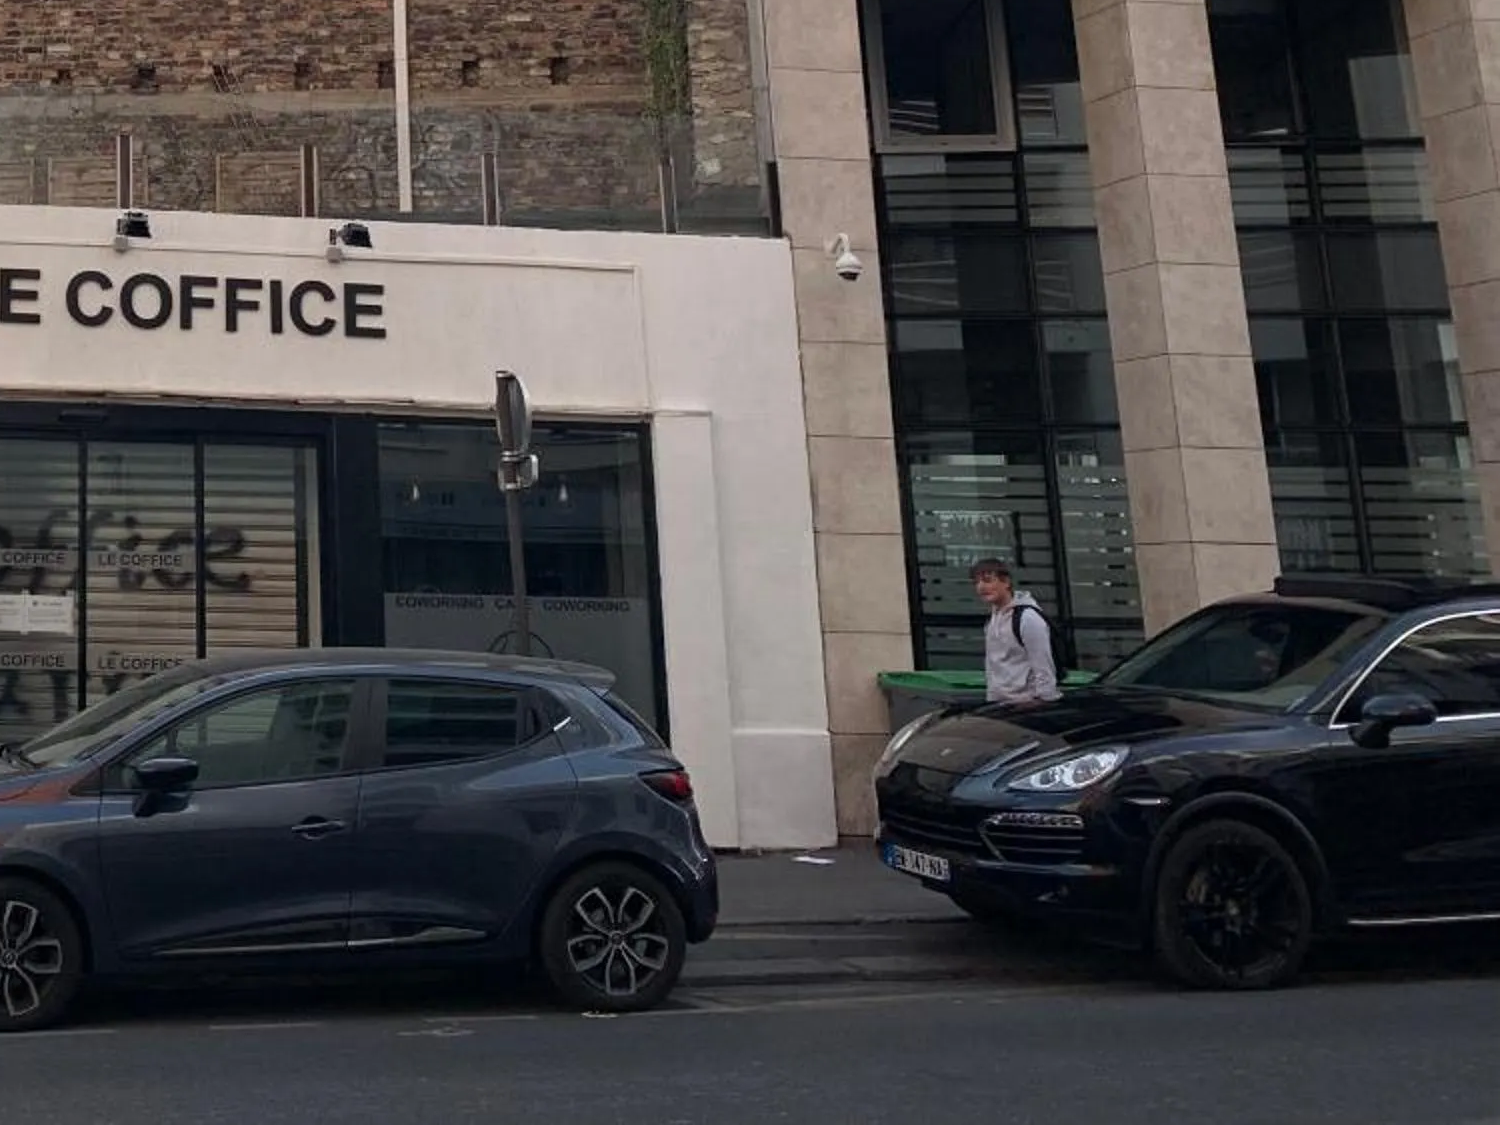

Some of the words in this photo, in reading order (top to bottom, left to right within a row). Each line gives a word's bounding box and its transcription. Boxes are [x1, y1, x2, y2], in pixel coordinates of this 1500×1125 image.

[65, 270, 387, 339] COFFICE
[3, 552, 65, 565] COFFICE
[99, 554, 117, 566] LE
[120, 554, 182, 567] COFFICE
[395, 596, 484, 610] COWORKING
[542, 600, 630, 613] COWORKING
[1, 655, 65, 668] COFFICE
[98, 658, 117, 670] LE
